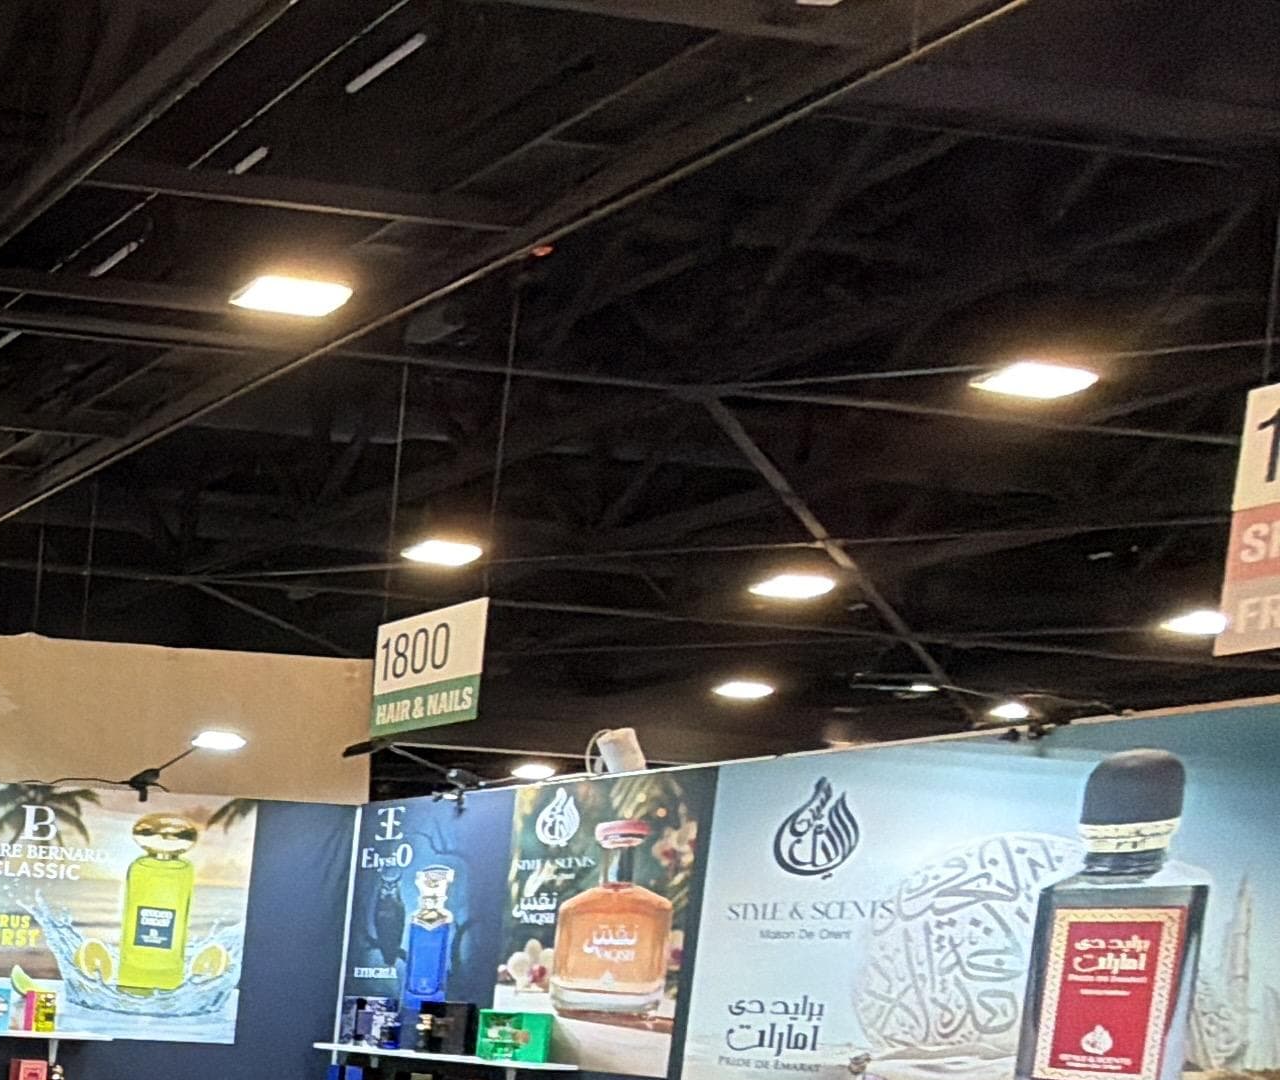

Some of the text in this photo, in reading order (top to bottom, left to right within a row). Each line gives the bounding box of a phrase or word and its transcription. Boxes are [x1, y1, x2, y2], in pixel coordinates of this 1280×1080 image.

[381, 622, 451, 681] 1800
[375, 686, 474, 726] HAIR & NAILS
[26, 845, 111, 864] BERNARD
[727, 900, 894, 922] STYLE & SCENTS
[718, 1054, 753, 1069] PRIDE
[754, 1059, 771, 1070] DE
